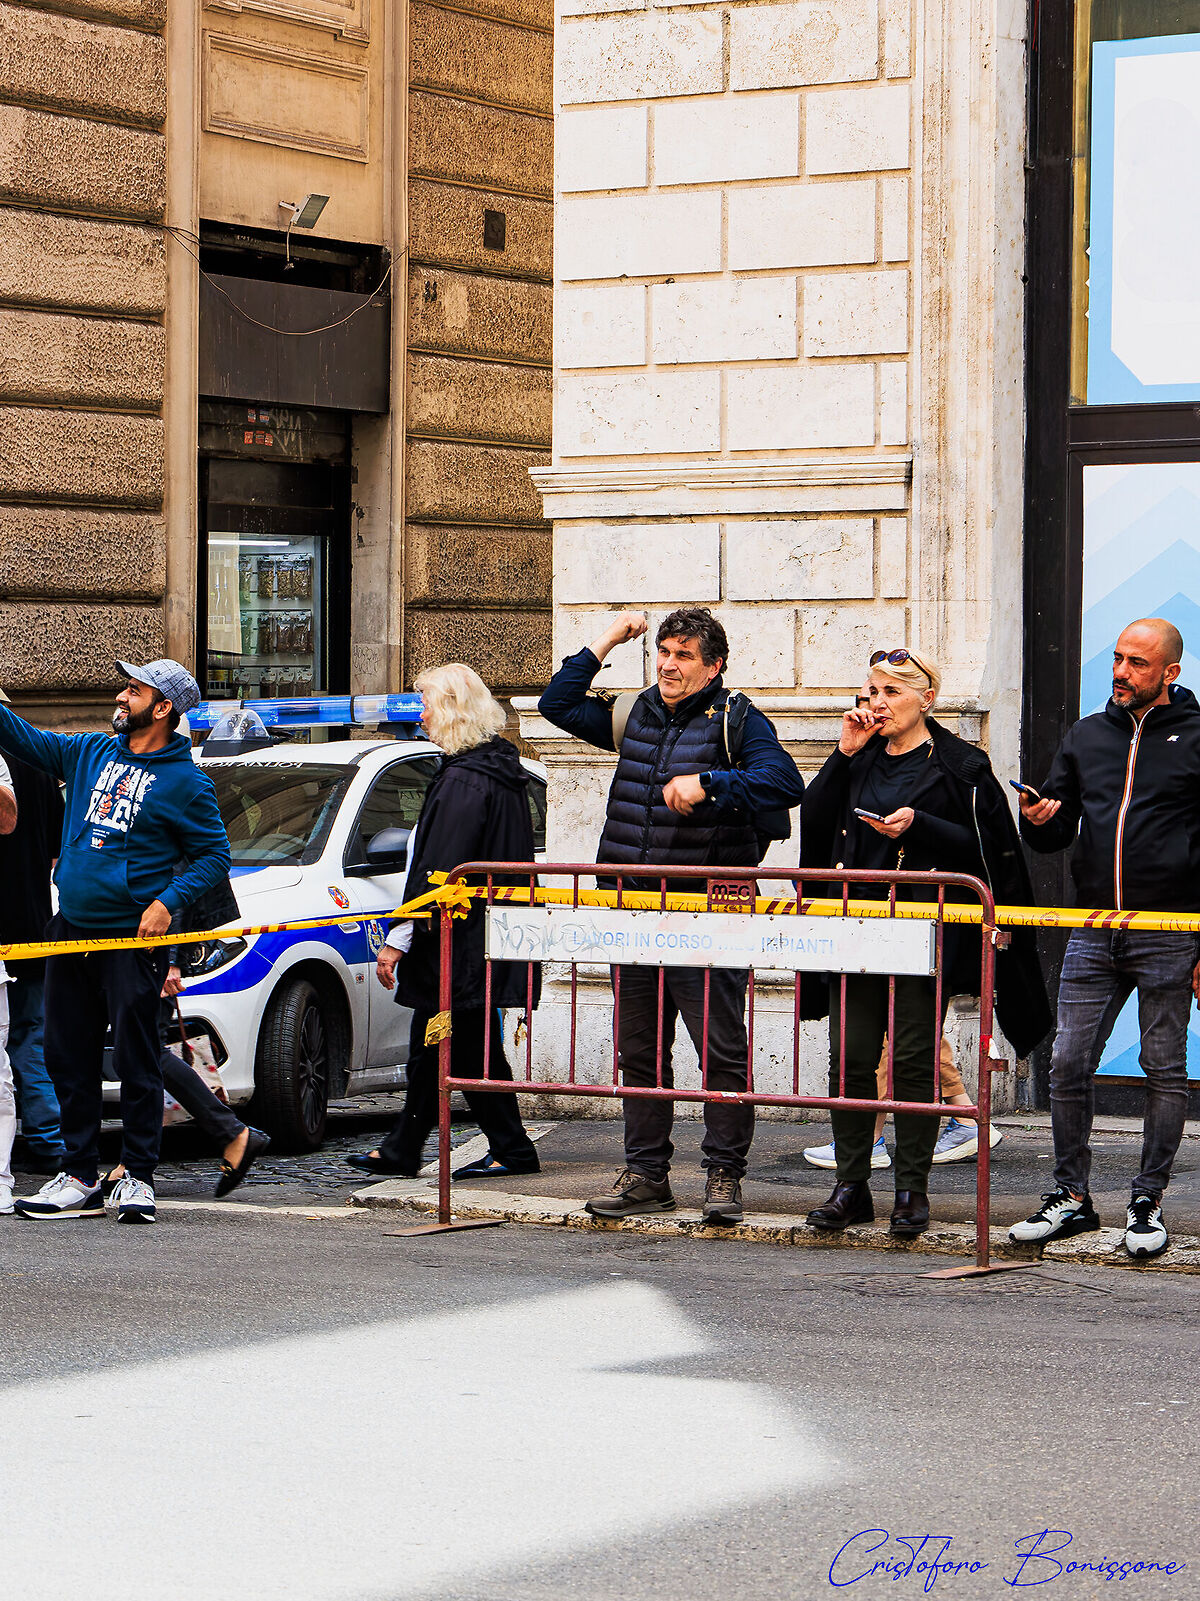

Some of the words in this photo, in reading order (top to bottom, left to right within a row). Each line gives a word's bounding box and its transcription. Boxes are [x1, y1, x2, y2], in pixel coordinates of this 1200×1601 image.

[573, 931, 629, 948] LAVORI
[634, 932, 651, 948] IN
[655, 933, 713, 950] CORSO
